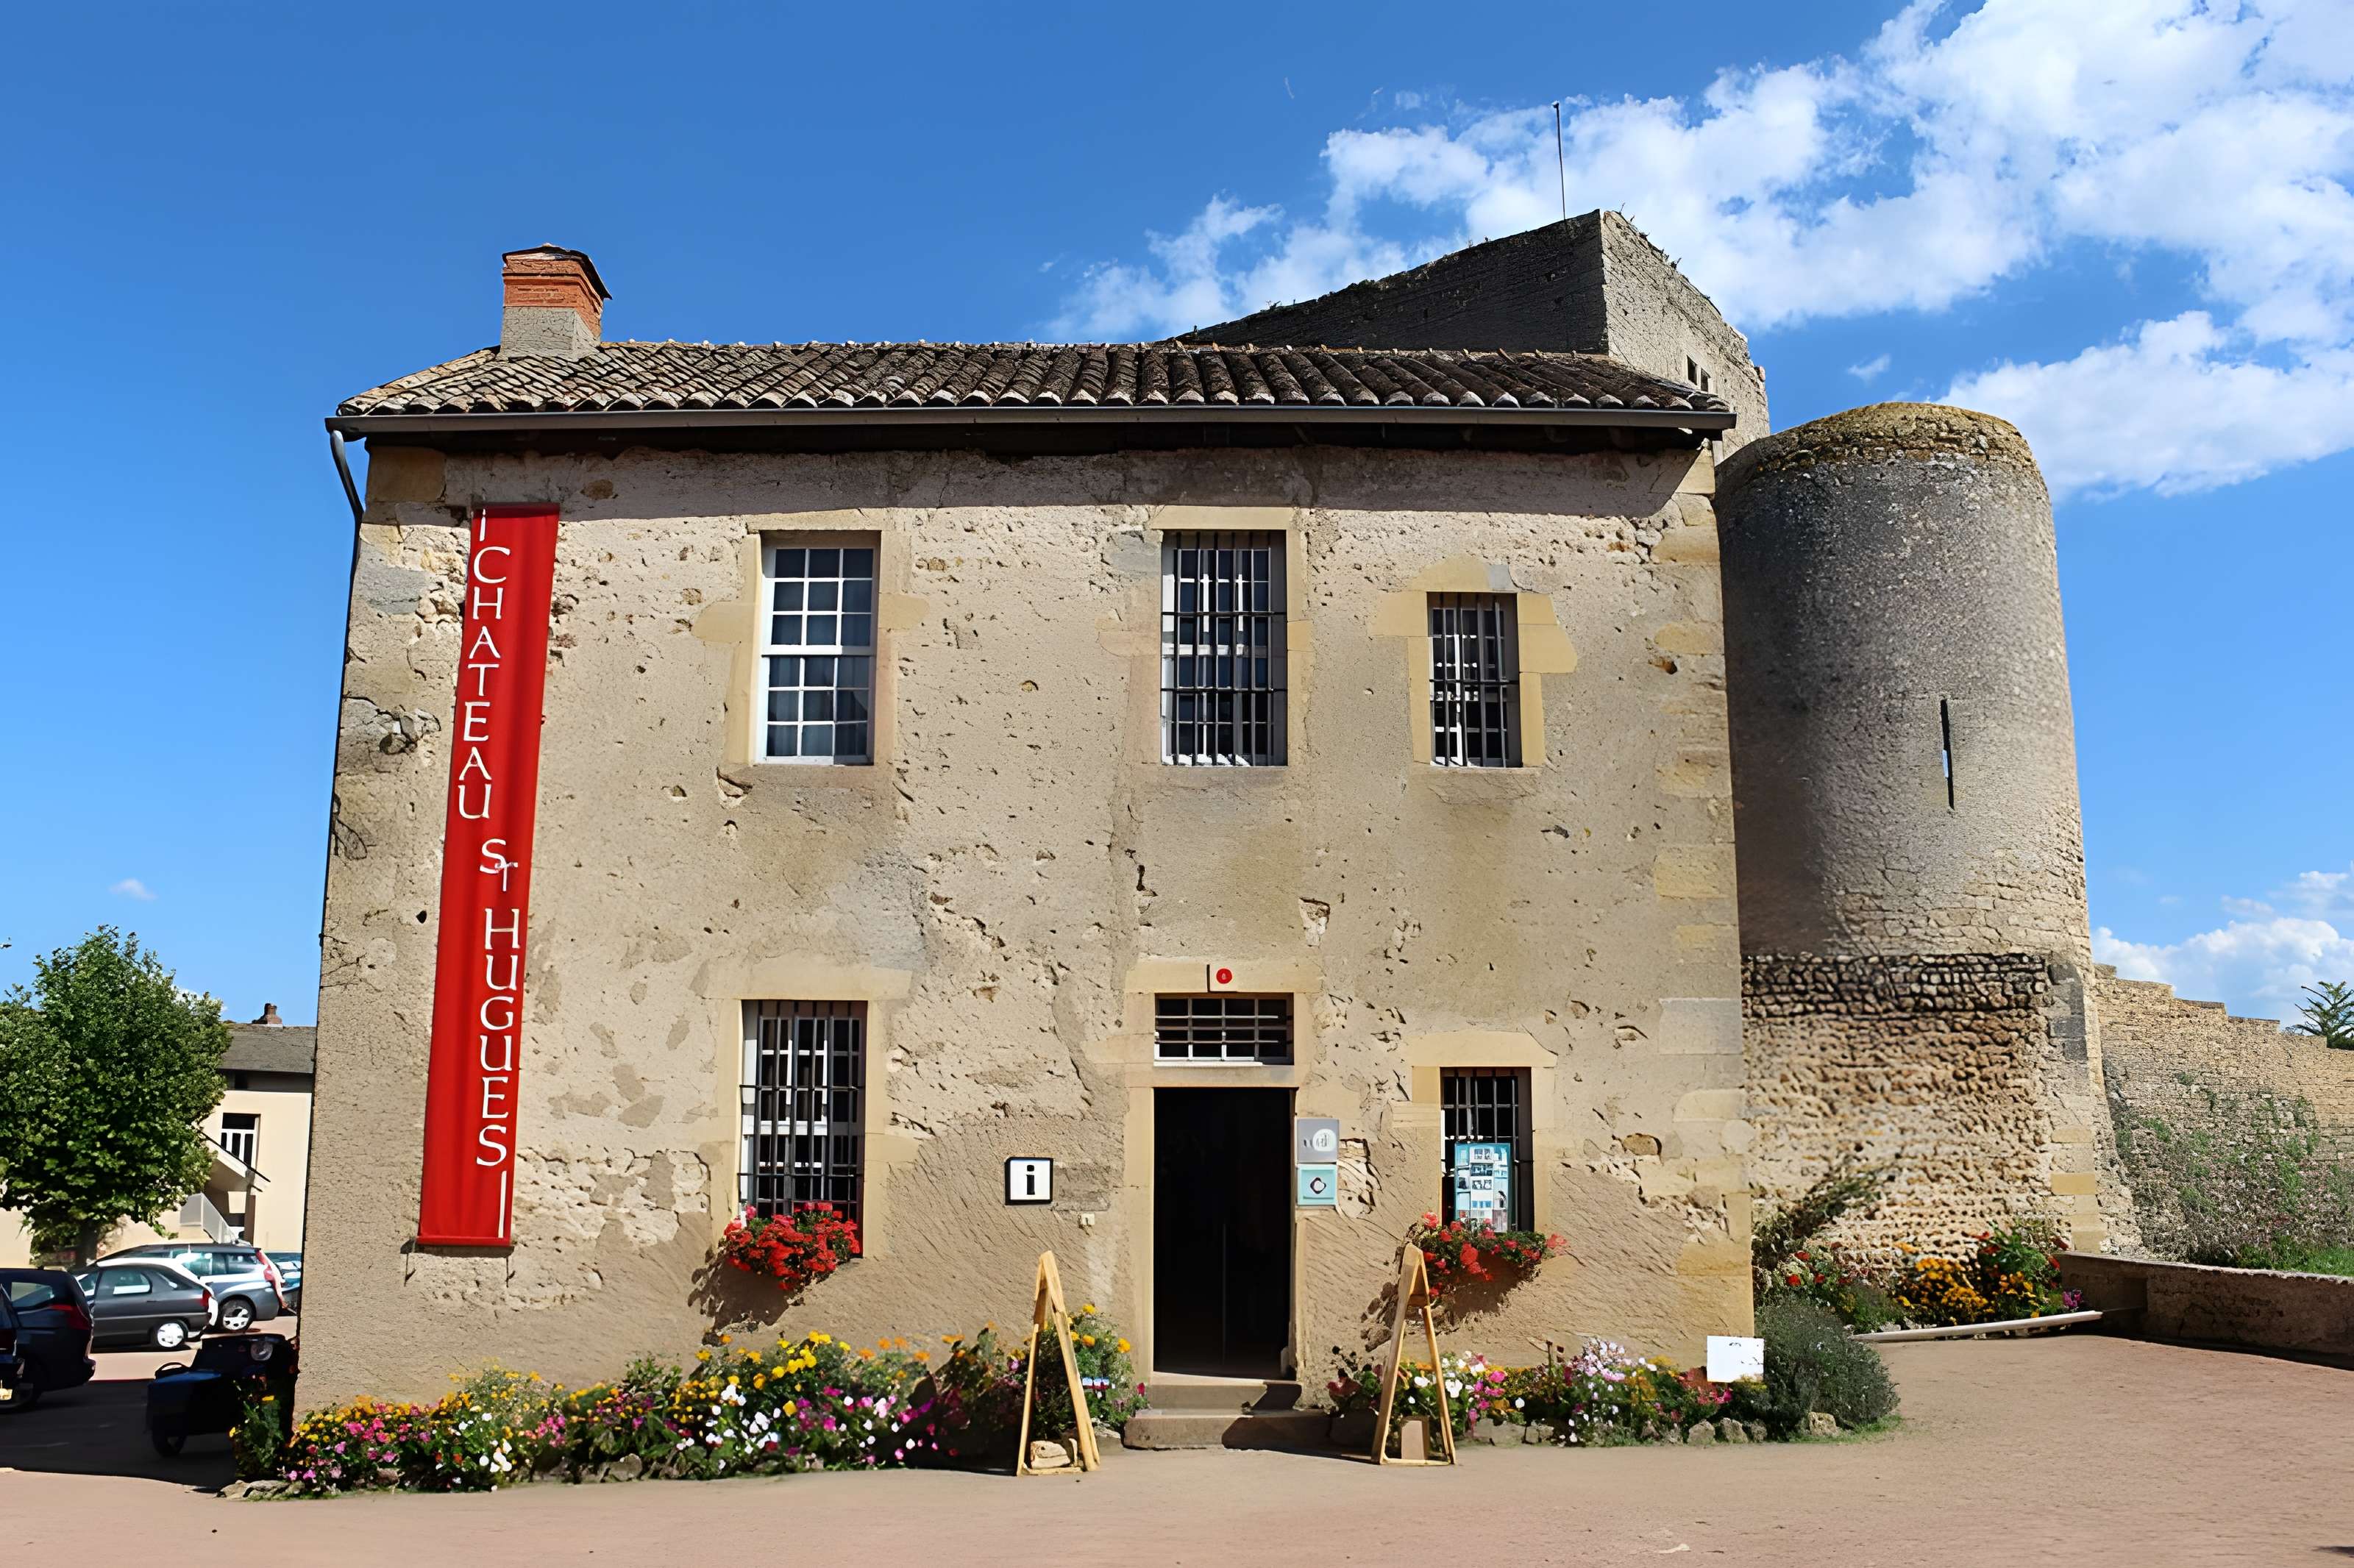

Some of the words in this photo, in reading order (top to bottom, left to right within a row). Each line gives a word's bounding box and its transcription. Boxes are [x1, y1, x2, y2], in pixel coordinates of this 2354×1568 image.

[458, 546, 511, 820] CHATEAU
[475, 908, 520, 1166] HUGUES
[1026, 1164, 1035, 1195] i
